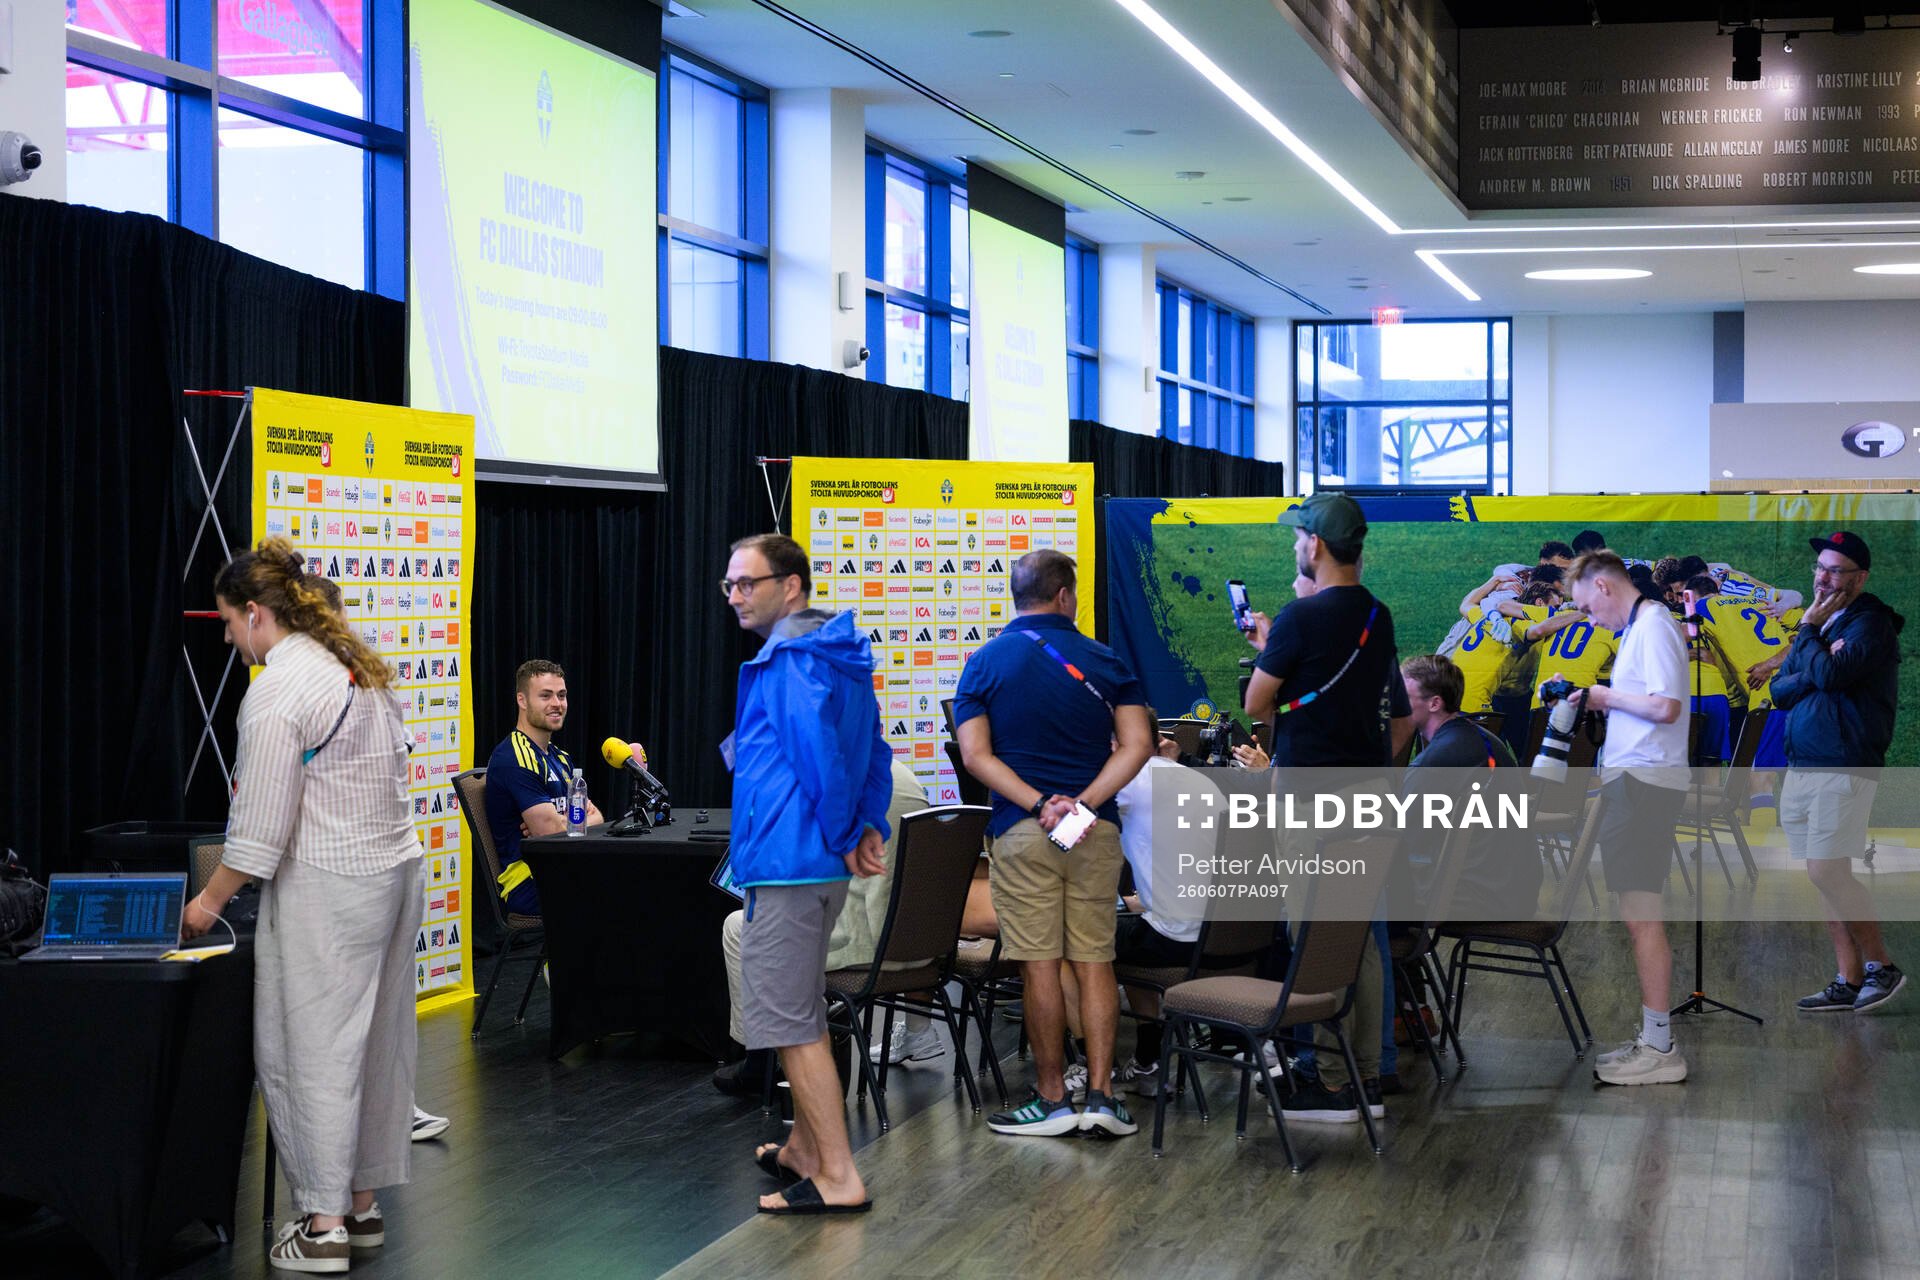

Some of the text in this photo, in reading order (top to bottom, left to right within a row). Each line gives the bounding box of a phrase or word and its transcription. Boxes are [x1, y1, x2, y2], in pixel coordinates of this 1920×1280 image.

[239, 1, 329, 55] Gallagher
[1621, 77, 1710, 95] BRIAN MCBRIDE
[1817, 73, 1869, 89] KRISTINE
[1872, 72, 1902, 87] LILLY
[1479, 81, 1567, 98] JOE-MAX MOORE
[1661, 108, 1762, 126] WERNER FRICKER
[1784, 105, 1862, 121] RON NEWMAN
[1877, 104, 1900, 119] 1993
[1480, 114, 1520, 130] EFRAIN
[1573, 112, 1639, 128] CHACURIAN
[1584, 142, 1673, 159] BERT PATENAUDE
[1684, 140, 1763, 157] ALLAN MCCLAY
[1774, 138, 1849, 155] JAMES MOORE
[1863, 137, 1917, 152] NICOLAAS
[1479, 145, 1573, 162] JACK ROTTENBERG
[1480, 177, 1591, 194] ANDREW M. BROWN
[1652, 173, 1743, 190] DICK SPALDING
[1763, 170, 1873, 188] ROBERT MORRISON
[504, 171, 584, 236] WELCOME TO
[479, 217, 604, 289] FC DALLAS STADIUM
[267, 426, 287, 439] SVENSKA
[288, 428, 297, 440] SPEL
[305, 430, 333, 444] FOTBOLLENS
[267, 441, 283, 454] STOLTA
[405, 441, 422, 453] SVENSKA
[423, 442, 432, 454] SPEL
[405, 454, 419, 466] STOLTA
[811, 480, 836, 488] SVENSKA
[852, 479, 860, 488] ÄR
[861, 481, 898, 489] FOTBOLLENS
[416, 490, 426, 506] ICA
[811, 489, 883, 498] STOLTA HUVUDSPONSOR
[995, 491, 1063, 500] STOLTA HUVUDSPONSOR
[1012, 516, 1026, 525] ICA
[346, 522, 357, 537] ICA
[916, 538, 930, 548] ICA
[433, 593, 443, 608] ICA
[916, 607, 930, 617] ICA
[938, 608, 957, 618] Fabege
[1740, 607, 1781, 646] 2
[1548, 621, 1595, 659] 10
[416, 765, 426, 779] ICA
[942, 789, 956, 799] ICA
